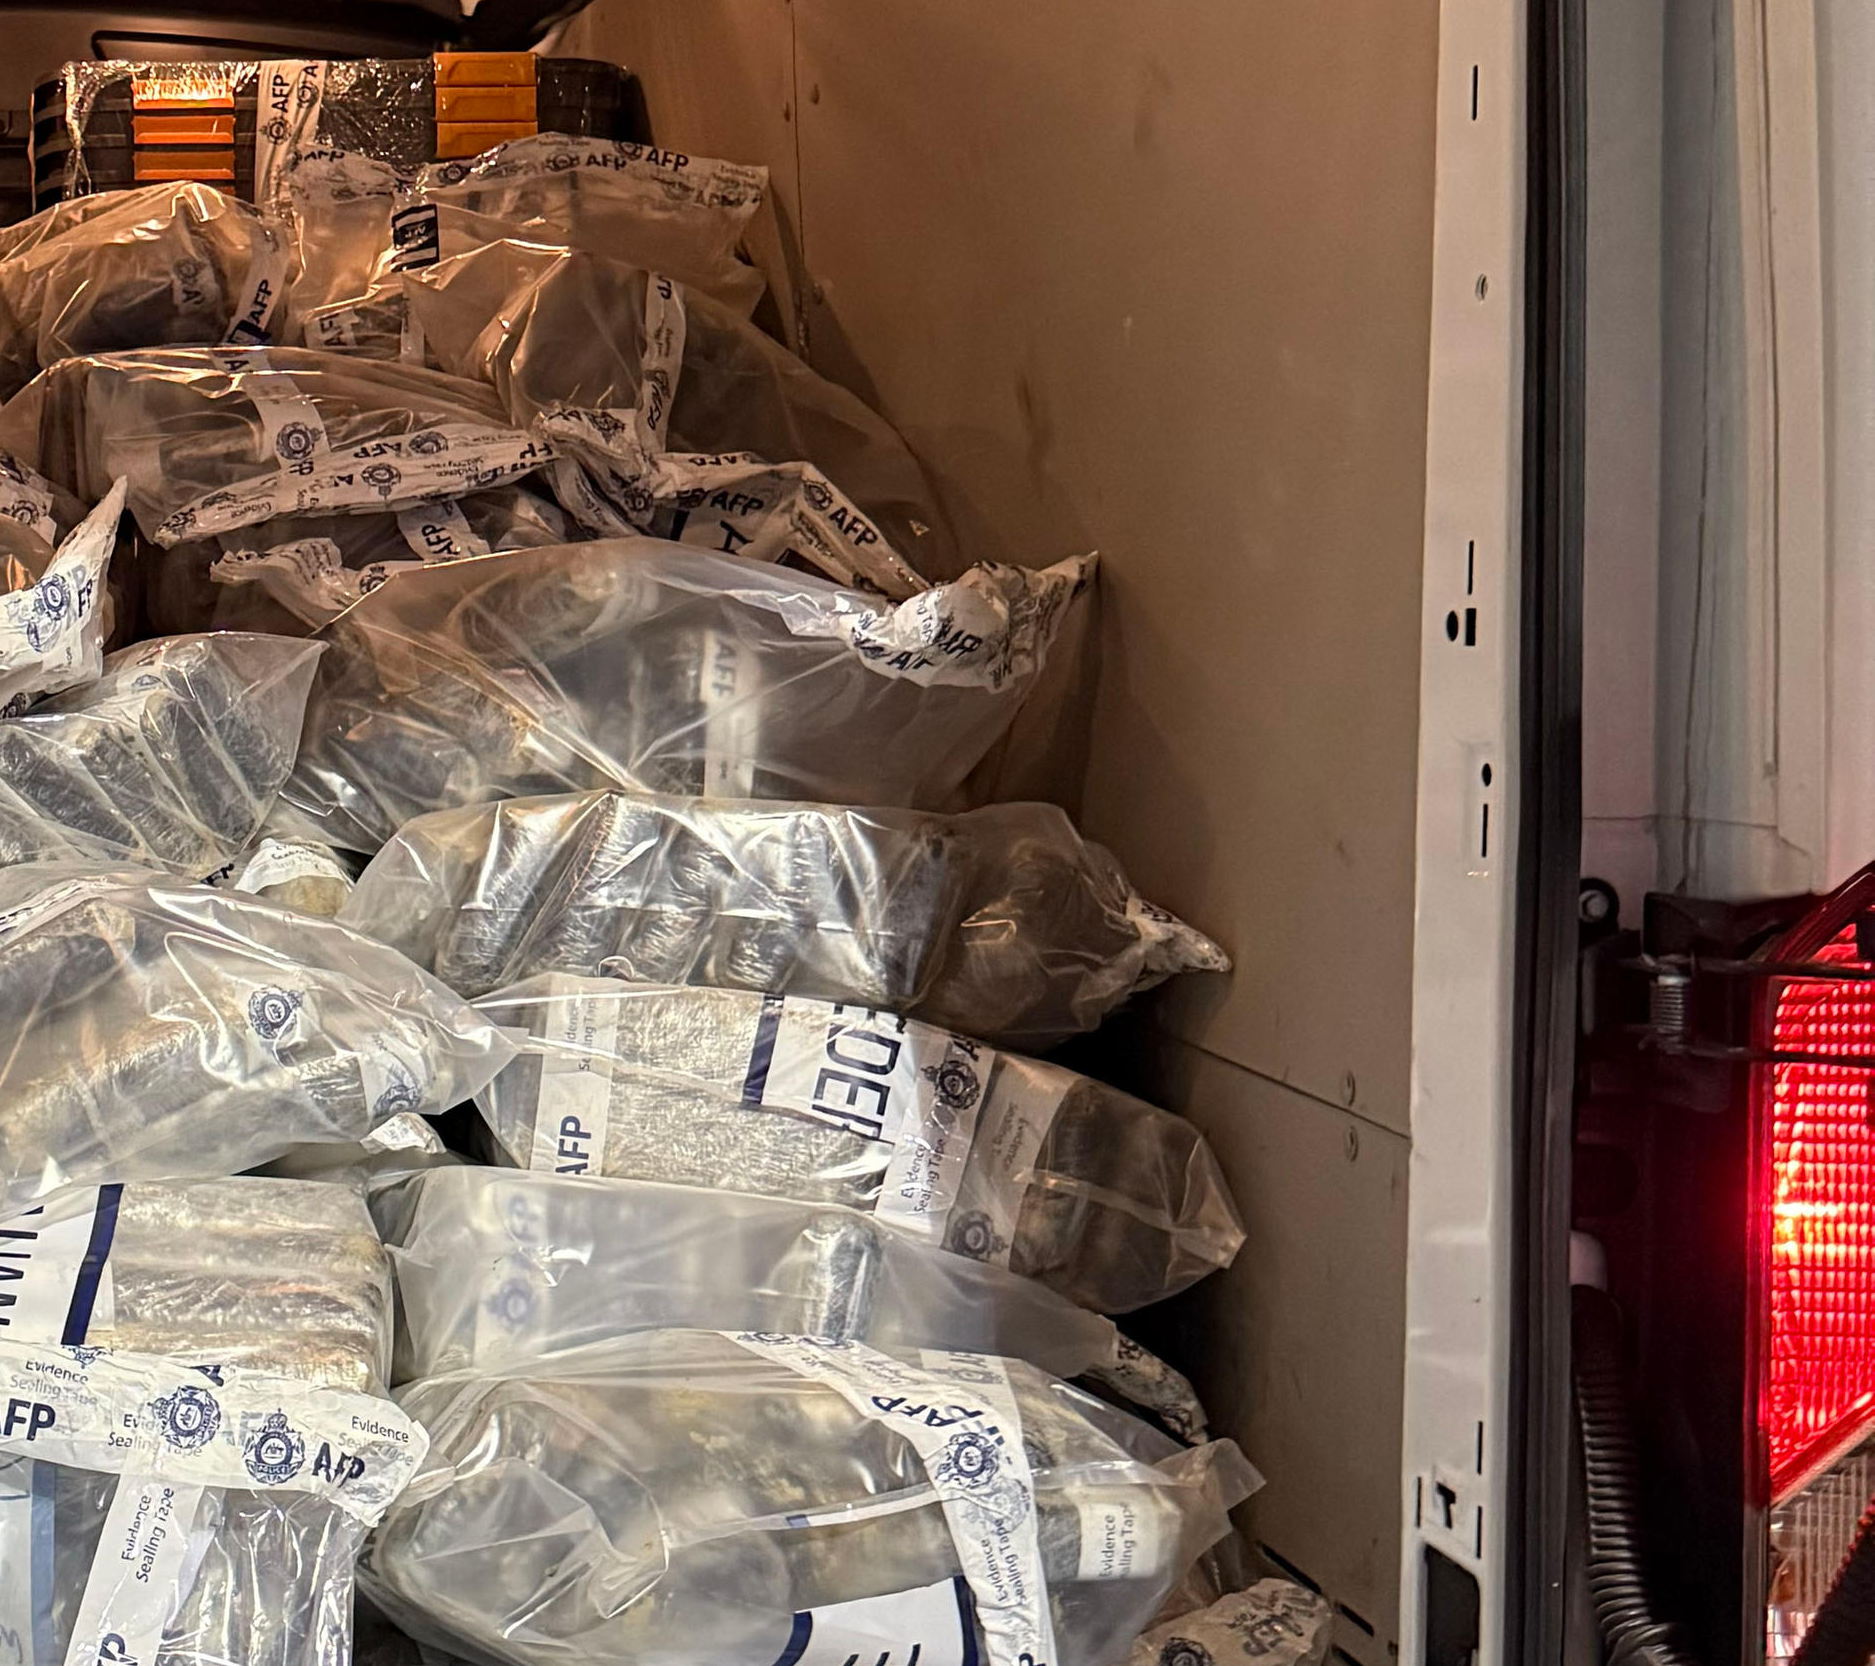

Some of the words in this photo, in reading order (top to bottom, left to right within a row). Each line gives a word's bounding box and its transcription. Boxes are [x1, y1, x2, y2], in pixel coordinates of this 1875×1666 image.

[272, 75, 289, 112] AFP
[646, 150, 688, 171] AFP
[250, 279, 272, 324] AFP
[710, 490, 763, 516] AFP
[829, 506, 880, 547] AFP
[351, 1414, 409, 1444] Evidence
[872, 1395, 956, 1427] AFP
[311, 1441, 366, 1488] AFP
[121, 1493, 152, 1561] Evidence
[136, 1526, 166, 1584] Sealing
[981, 1537, 1009, 1603] Evidence
